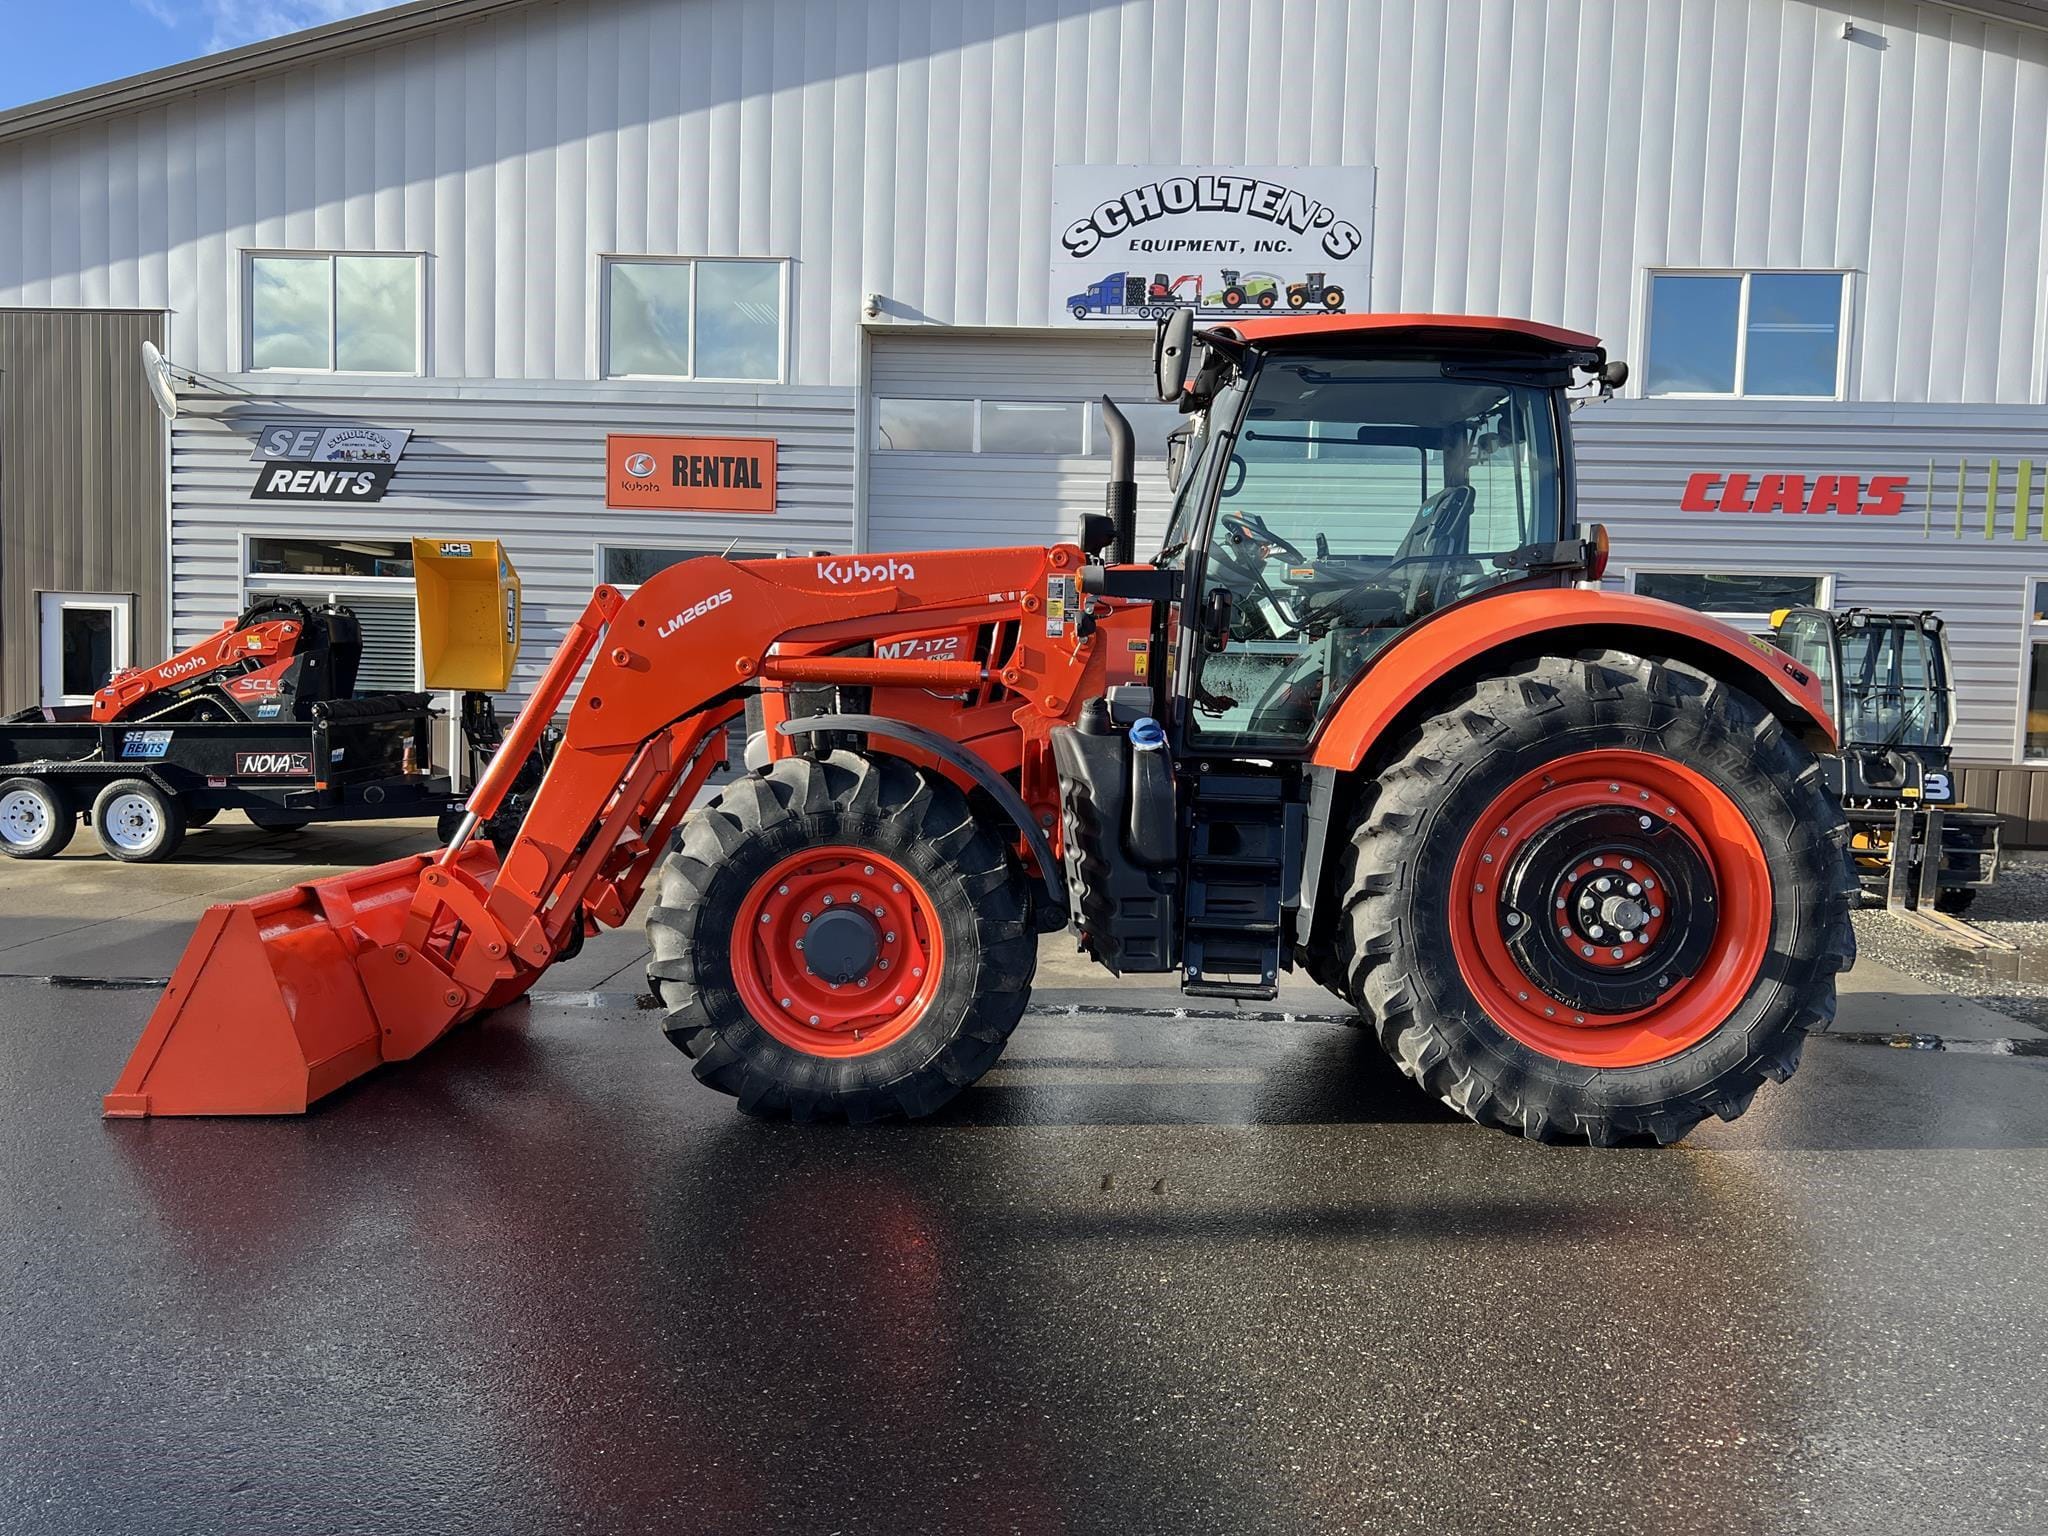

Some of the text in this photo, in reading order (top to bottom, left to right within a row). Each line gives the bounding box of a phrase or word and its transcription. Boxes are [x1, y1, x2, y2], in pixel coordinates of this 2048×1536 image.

[1062, 175, 1362, 259] SCHOLTEN'S
[1129, 239, 1293, 254] EQUIPMENT, INC.
[264, 429, 320, 457] SE
[327, 429, 393, 450] SCHOLTEN'S
[266, 469, 376, 495] RENTS
[621, 455, 762, 492] Kubota RENTAL
[1680, 473, 1909, 515] CLAAS
[440, 543, 471, 552] JCB
[817, 558, 915, 584] Kubota
[657, 588, 733, 639] LM2605
[878, 637, 958, 660] M7-172
[158, 656, 207, 678] Kubota
[239, 679, 276, 690] SCL
[124, 731, 144, 743] SE
[127, 743, 164, 753] RENTS
[242, 754, 290, 773] NOVA
